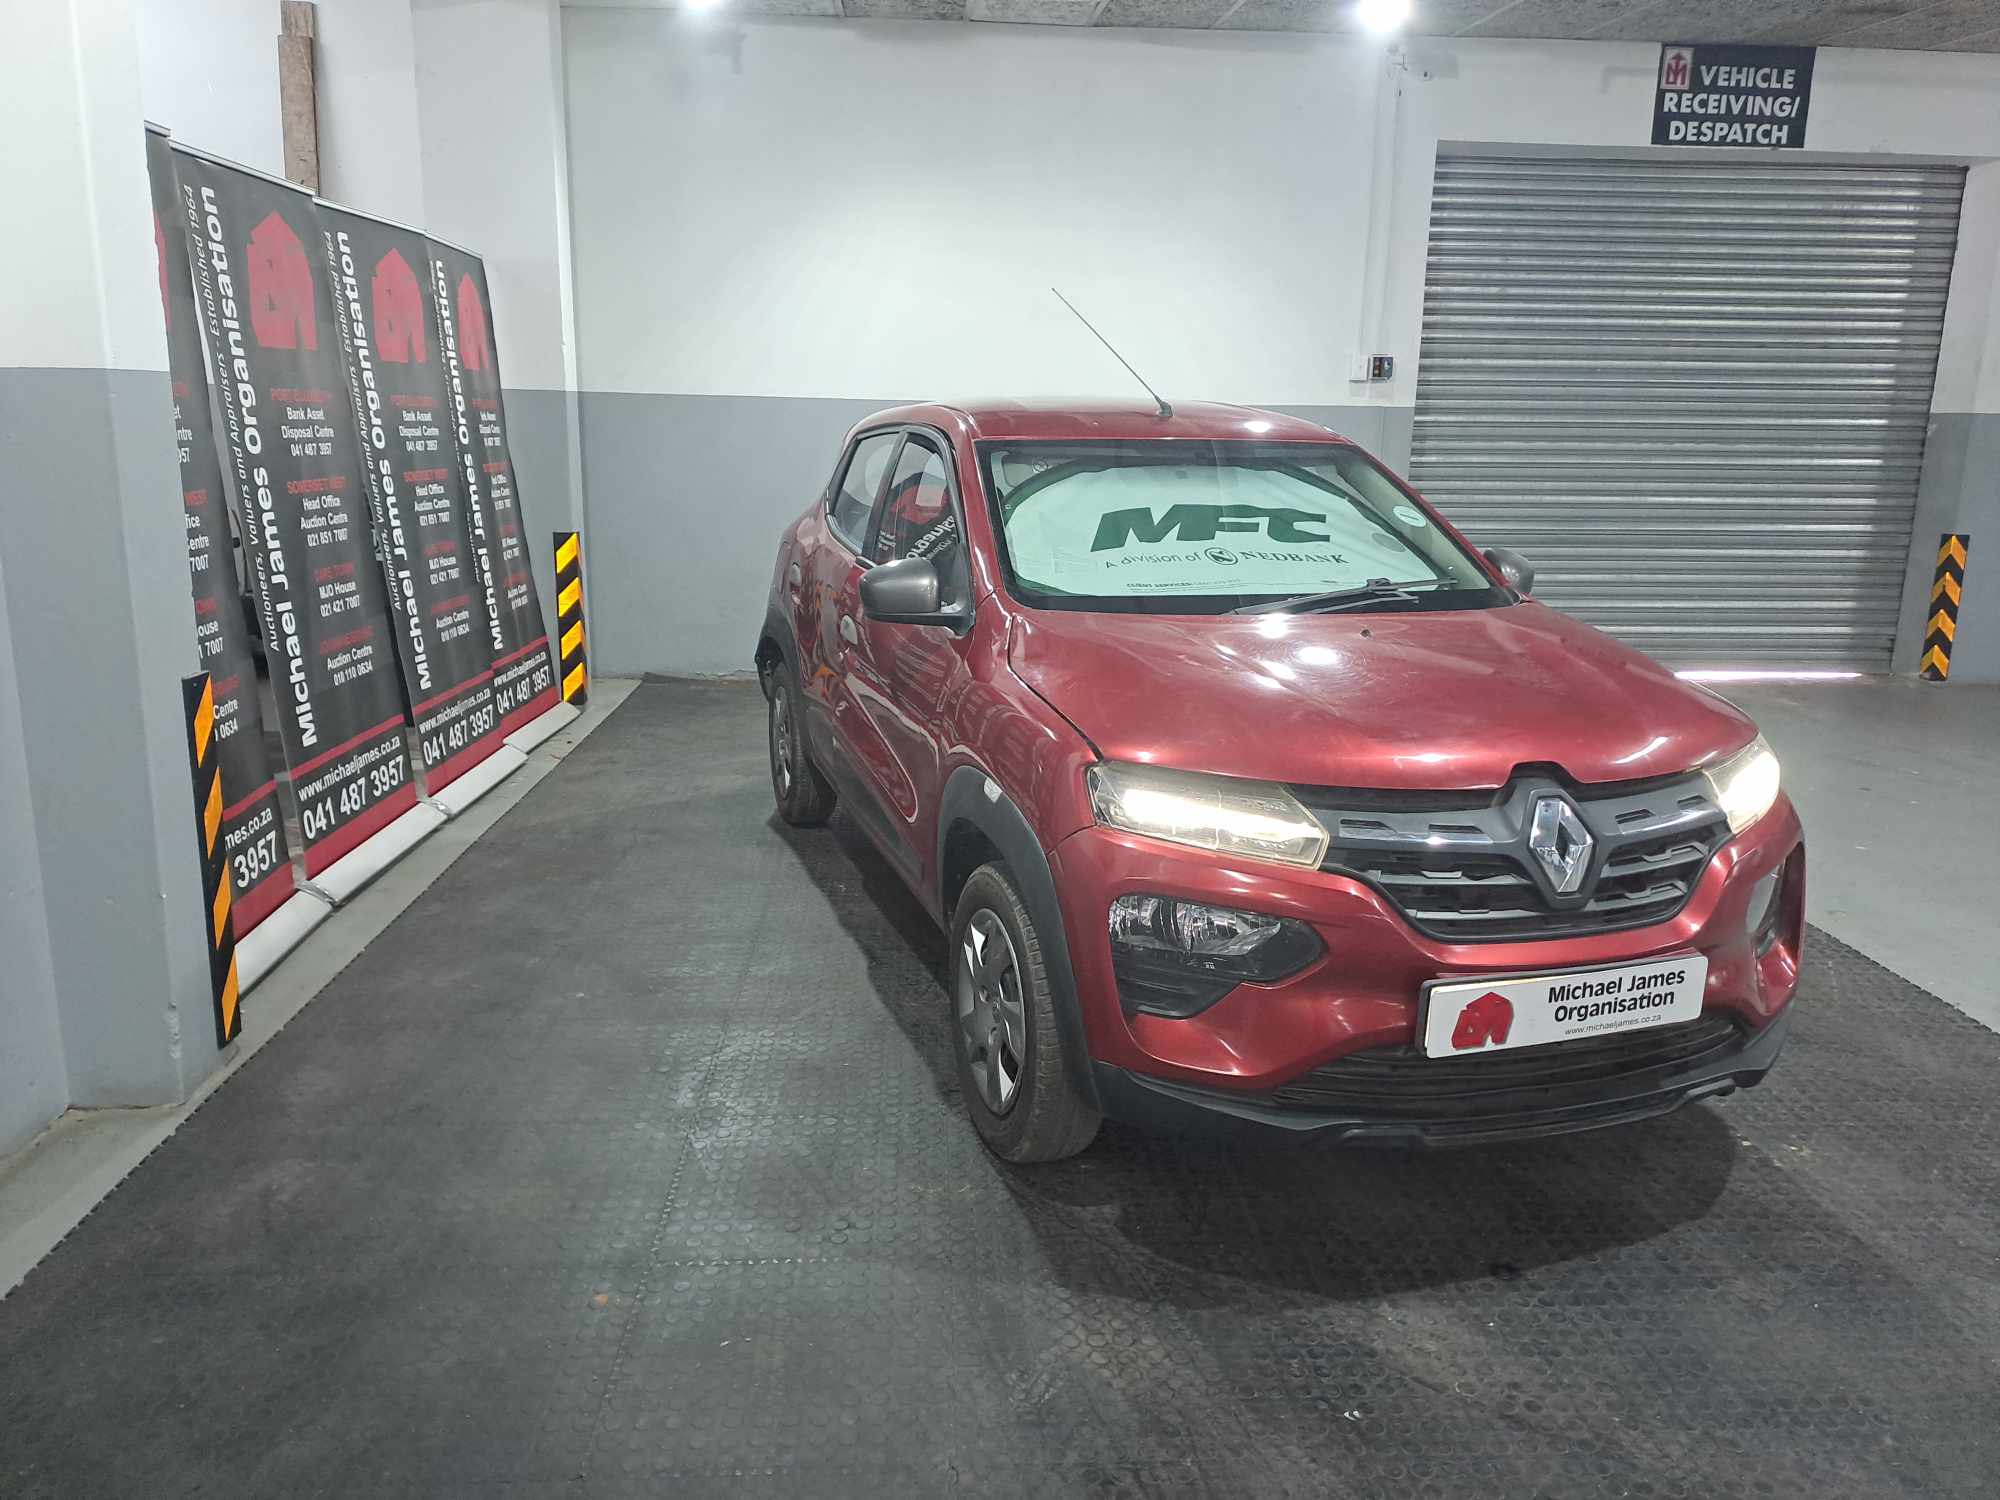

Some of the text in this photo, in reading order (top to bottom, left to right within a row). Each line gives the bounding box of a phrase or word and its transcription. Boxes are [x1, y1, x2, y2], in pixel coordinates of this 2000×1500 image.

[1700, 65, 1796, 90] VEHICLE
[1663, 92, 1801, 118] RECEIVING/
[1668, 120, 1789, 145] DESPATCH
[183, 184, 200, 229] 1964
[191, 233, 220, 337] Established
[435, 259, 470, 446] Organisation
[216, 352, 241, 443] Appraisers
[286, 406, 306, 421] Bank
[281, 425, 313, 441] Disposal
[232, 446, 247, 480] and
[290, 443, 303, 457] 041
[304, 443, 317, 456] 487
[337, 231, 432, 691] Michael James Organisation
[201, 185, 318, 748] Michael James Organisation
[302, 496, 320, 511] Head
[463, 453, 486, 541] James
[241, 485, 260, 545] Valuers
[300, 515, 327, 530] Auction
[1090, 504, 1331, 552] MFC
[187, 533, 210, 550] entre
[307, 532, 319, 547] 021
[319, 530, 333, 545] 851
[1105, 551, 1351, 569] A division of NEDBANK
[255, 552, 280, 652] Auctioneers,
[335, 580, 357, 595] House
[477, 548, 504, 650] Michael
[320, 603, 332, 617] 021
[333, 599, 345, 613] 421
[197, 620, 219, 637] ouse
[205, 637, 223, 657] 7007
[327, 653, 351, 671] Auction
[496, 665, 550, 714] 041 487 3957
[212, 699, 238, 720] Centre
[219, 717, 239, 739] 0634
[423, 703, 494, 765] 041 487 3957
[298, 735, 401, 802] www.michaeljames.co.za
[302, 754, 404, 840] 041 487 3957
[233, 829, 277, 888] 3957
[1548, 969, 1686, 1003] Michael James
[1554, 991, 1675, 1023] Organisation
[1564, 1013, 1662, 1036] www.michaeljames.co.za
